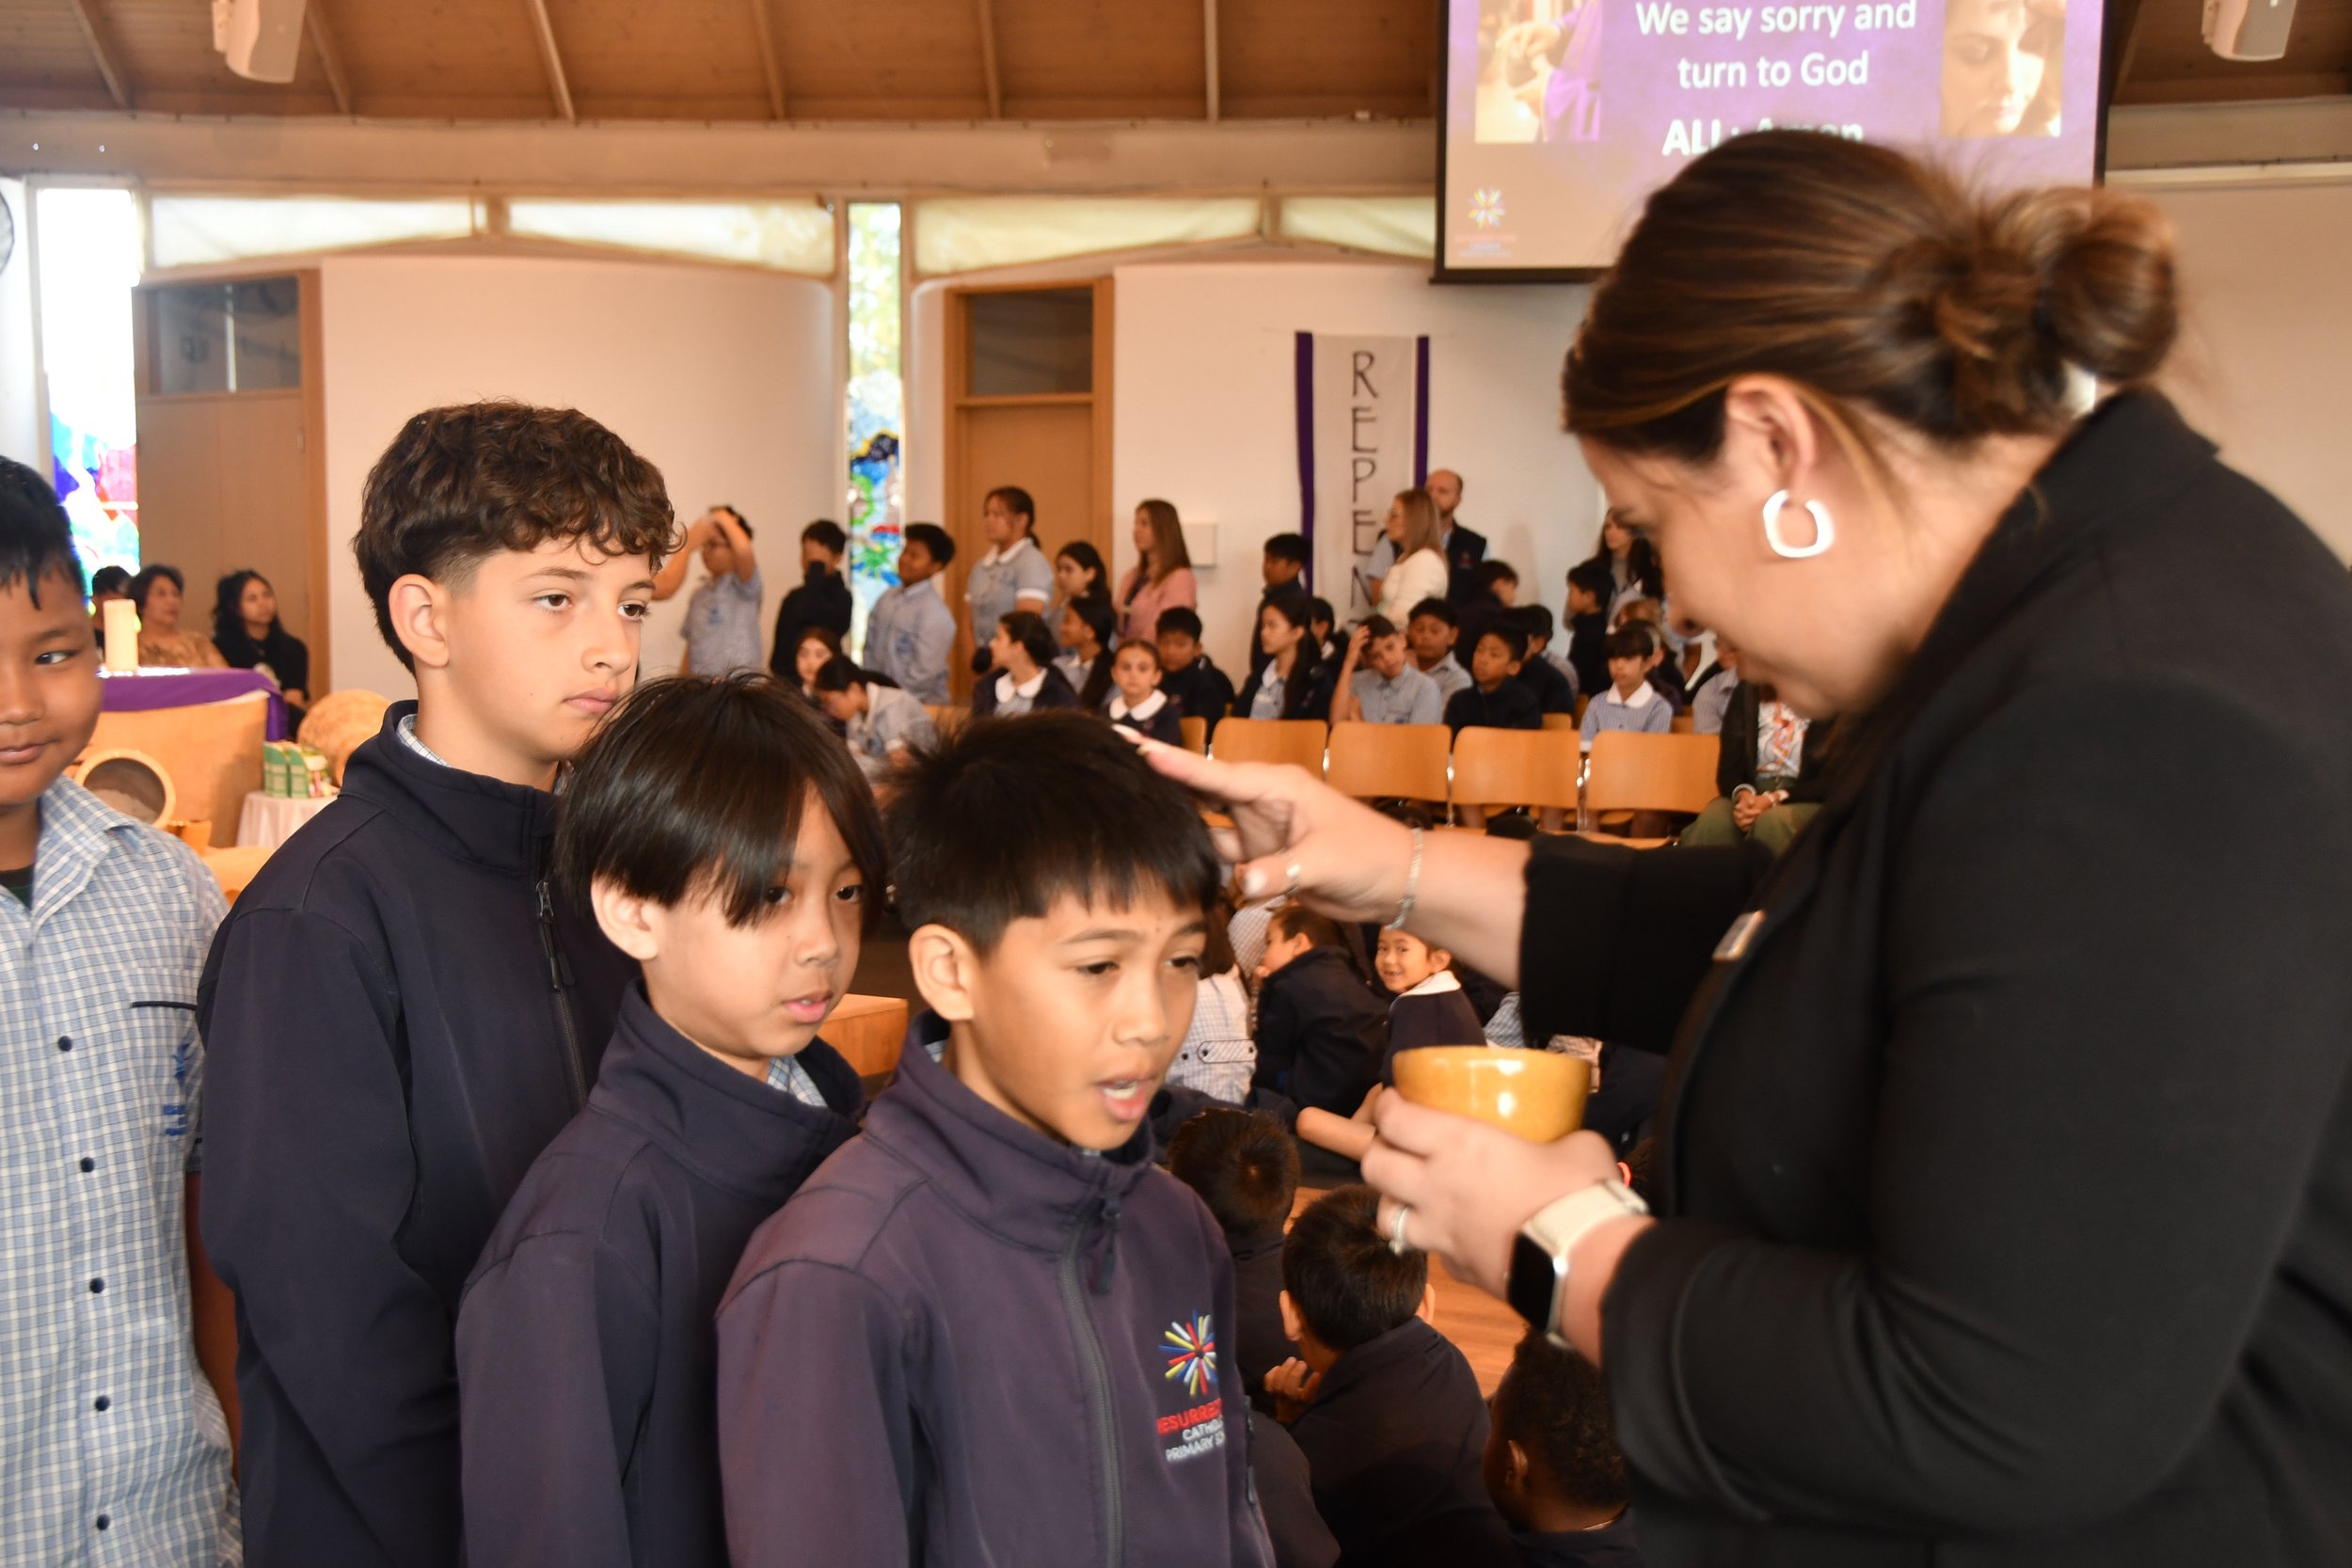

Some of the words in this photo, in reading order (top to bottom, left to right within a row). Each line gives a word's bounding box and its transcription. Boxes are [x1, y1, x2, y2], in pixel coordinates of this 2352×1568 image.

[1635, 2, 1690, 35] We
[1698, 7, 1753, 40] say
[1760, 5, 1846, 39] sorry
[1854, 0, 1916, 30] and
[1677, 57, 1747, 89] turn
[1756, 56, 1792, 87] to
[1801, 50, 1869, 87] God
[1347, 350, 1379, 625] REPEN
[1165, 1434, 1214, 1463] PRIMARY
